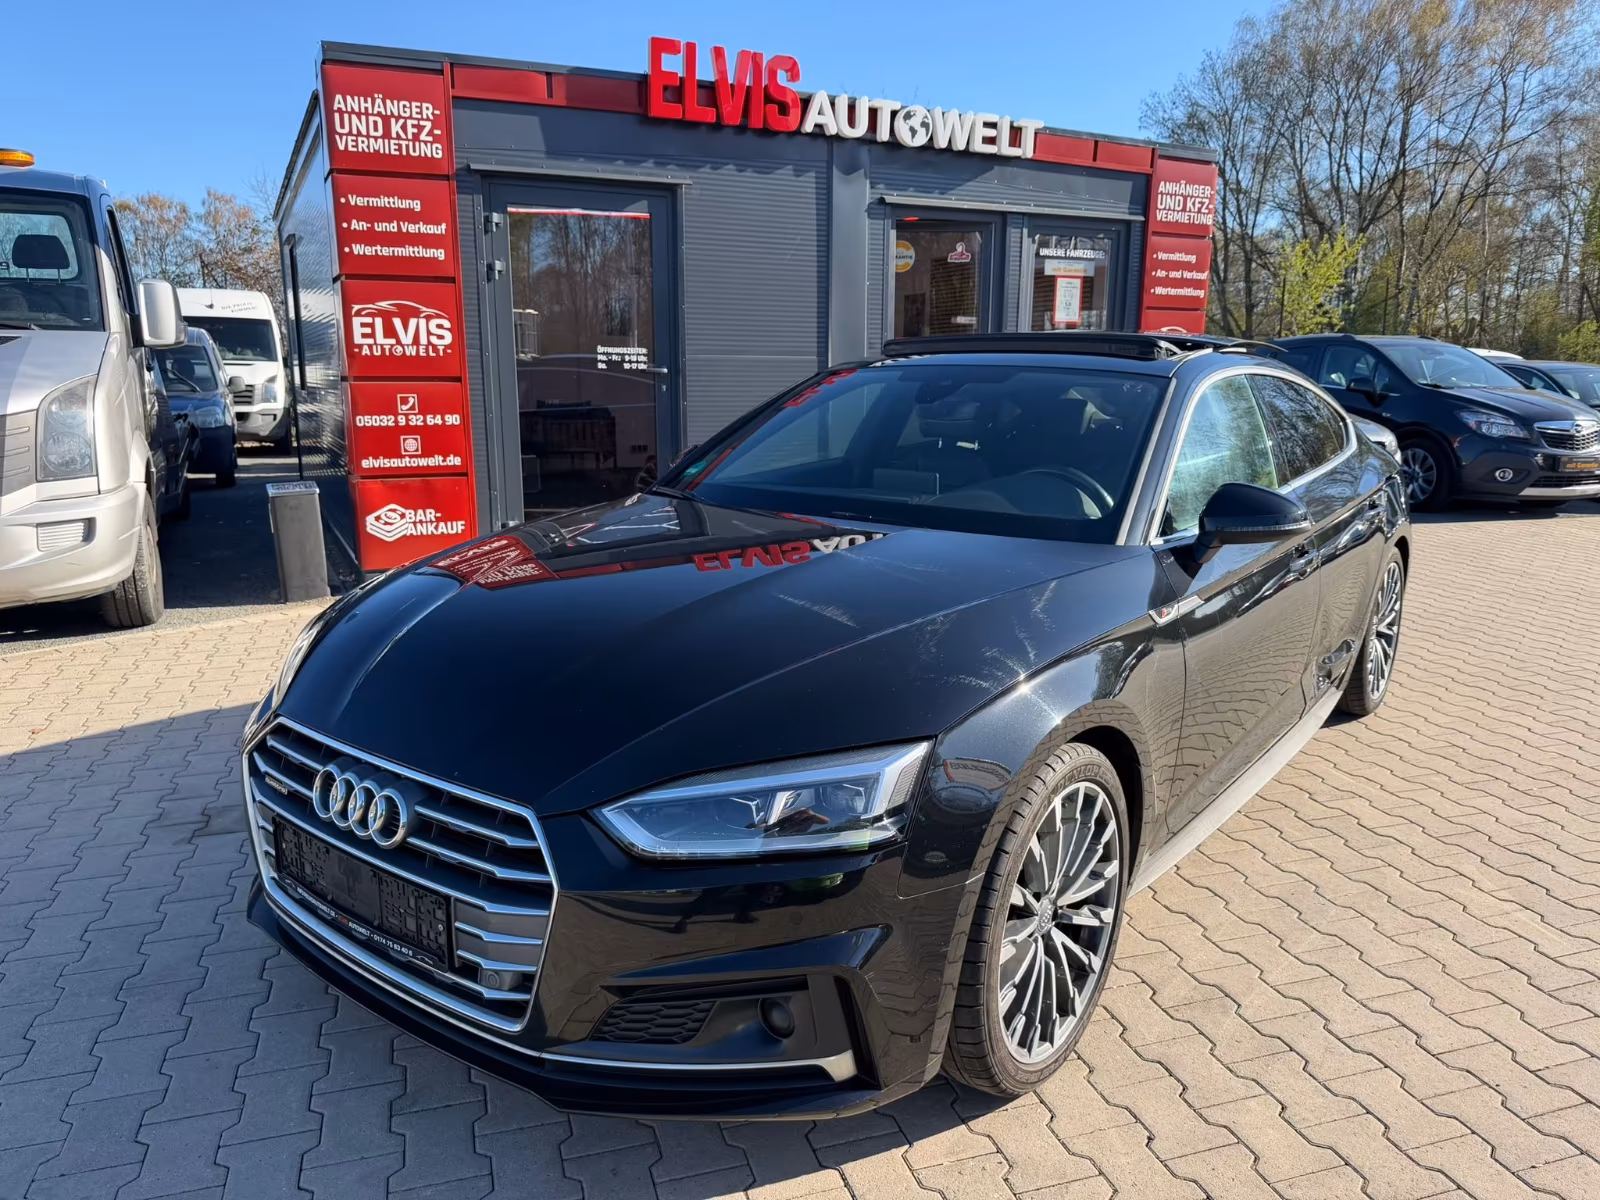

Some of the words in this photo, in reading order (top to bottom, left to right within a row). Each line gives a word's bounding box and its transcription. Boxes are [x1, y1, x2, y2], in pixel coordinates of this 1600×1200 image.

[333, 93, 441, 120] ANHÄNGER-
[648, 36, 801, 132] ELVIS
[801, 90, 1044, 160] AUTOWELT
[334, 112, 384, 137] UND
[391, 118, 442, 143] KFZ-
[335, 134, 443, 160] VERMIETUNG
[1158, 179, 1215, 198] ANHÄNGER-
[348, 194, 421, 212] Vermittlung
[1157, 194, 1184, 211] UND
[1186, 197, 1214, 214] KFZ-
[1156, 209, 1213, 226] VERMIETUNG
[351, 221, 371, 232] An-
[374, 221, 398, 233] und
[400, 221, 447, 236] Verkauf
[352, 243, 445, 260] Wertermittlung
[1039, 247, 1066, 257] UNSERE
[1066, 249, 1106, 259] FAHRZEUGE:
[1158, 251, 1197, 263] Vermittlung
[1156, 269, 1168, 278] An-
[1169, 270, 1182, 279] und
[1182, 270, 1208, 280] Verkauf
[1154, 286, 1205, 299] Wertermittlung
[352, 316, 453, 346] ELVIS
[597, 344, 648, 354] ÖFFNUNGSZEITEN:
[356, 415, 396, 427] 05032
[397, 415, 406, 427] 9
[408, 414, 424, 427] 32
[426, 414, 443, 427] 64
[445, 414, 461, 426] 90
[361, 453, 461, 470] elvisautowelt.de
[405, 508, 442, 523] BAR-
[406, 520, 466, 537] ANKAUF
[348, 921, 370, 937] AUTOWELT
[374, 934, 386, 944] 0174
[386, 940, 393, 948] 75
